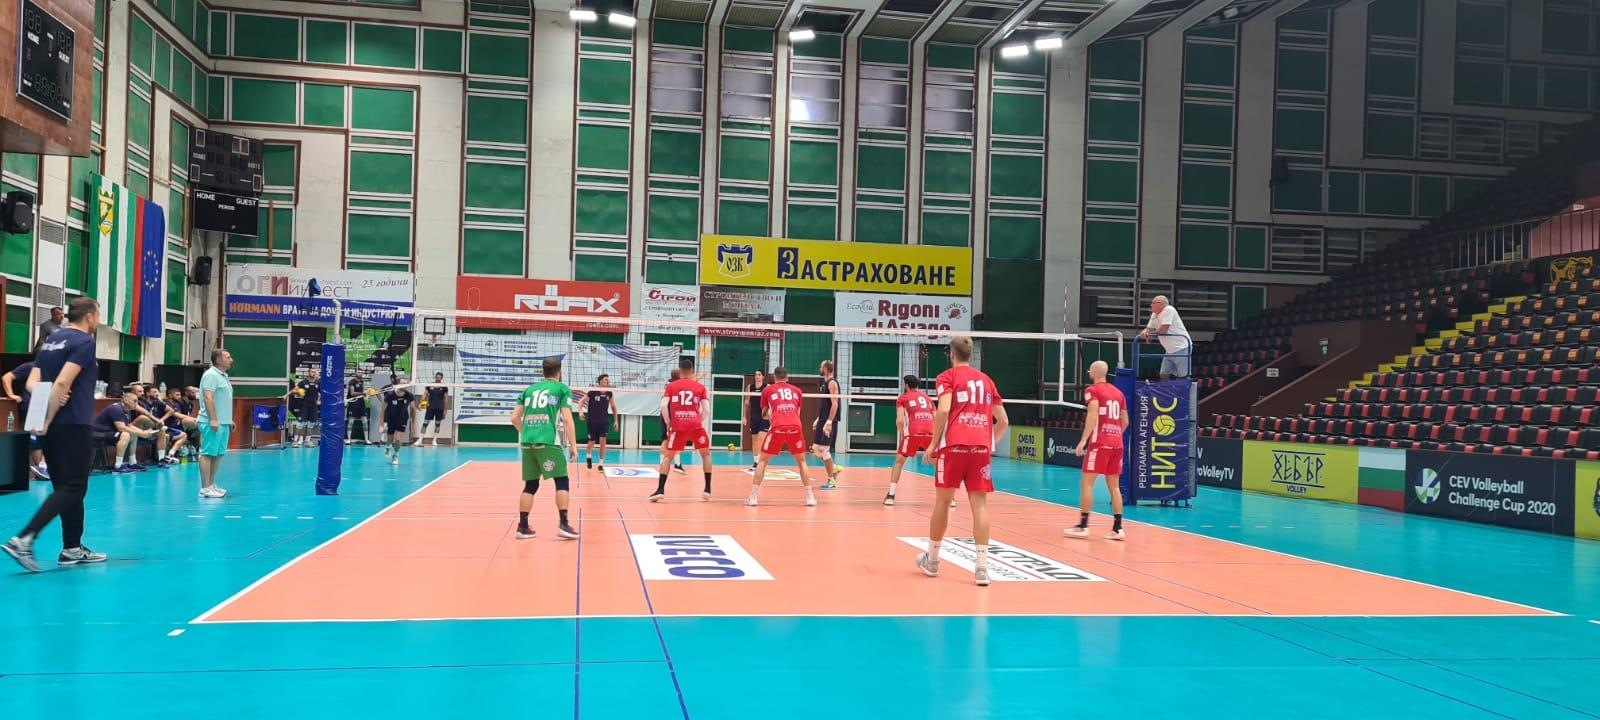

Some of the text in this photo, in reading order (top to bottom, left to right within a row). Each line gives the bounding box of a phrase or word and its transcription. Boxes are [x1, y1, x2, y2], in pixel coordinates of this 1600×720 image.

[196, 192, 216, 201] HOME
[236, 198, 257, 207] GUEST
[778, 247, 956, 287] ЗАСТРАХОВАНЕ
[361, 280, 374, 289] 25
[878, 299, 940, 320] Rigoni
[532, 389, 549, 409] 16
[678, 390, 693, 406] 12
[777, 387, 793, 401] 18
[966, 379, 985, 405] 11
[917, 396, 928, 409] 9
[1105, 399, 1120, 420] 10
[1138, 395, 1149, 489] РЕКЛАМНА АГЕНЦИЯ
[1286, 484, 1307, 494] VOLLEY
[1449, 475, 1525, 495] CEV Volleyball
[1448, 491, 1557, 516] Challenge Cup 2020
[652, 535, 746, 579] IVECO
